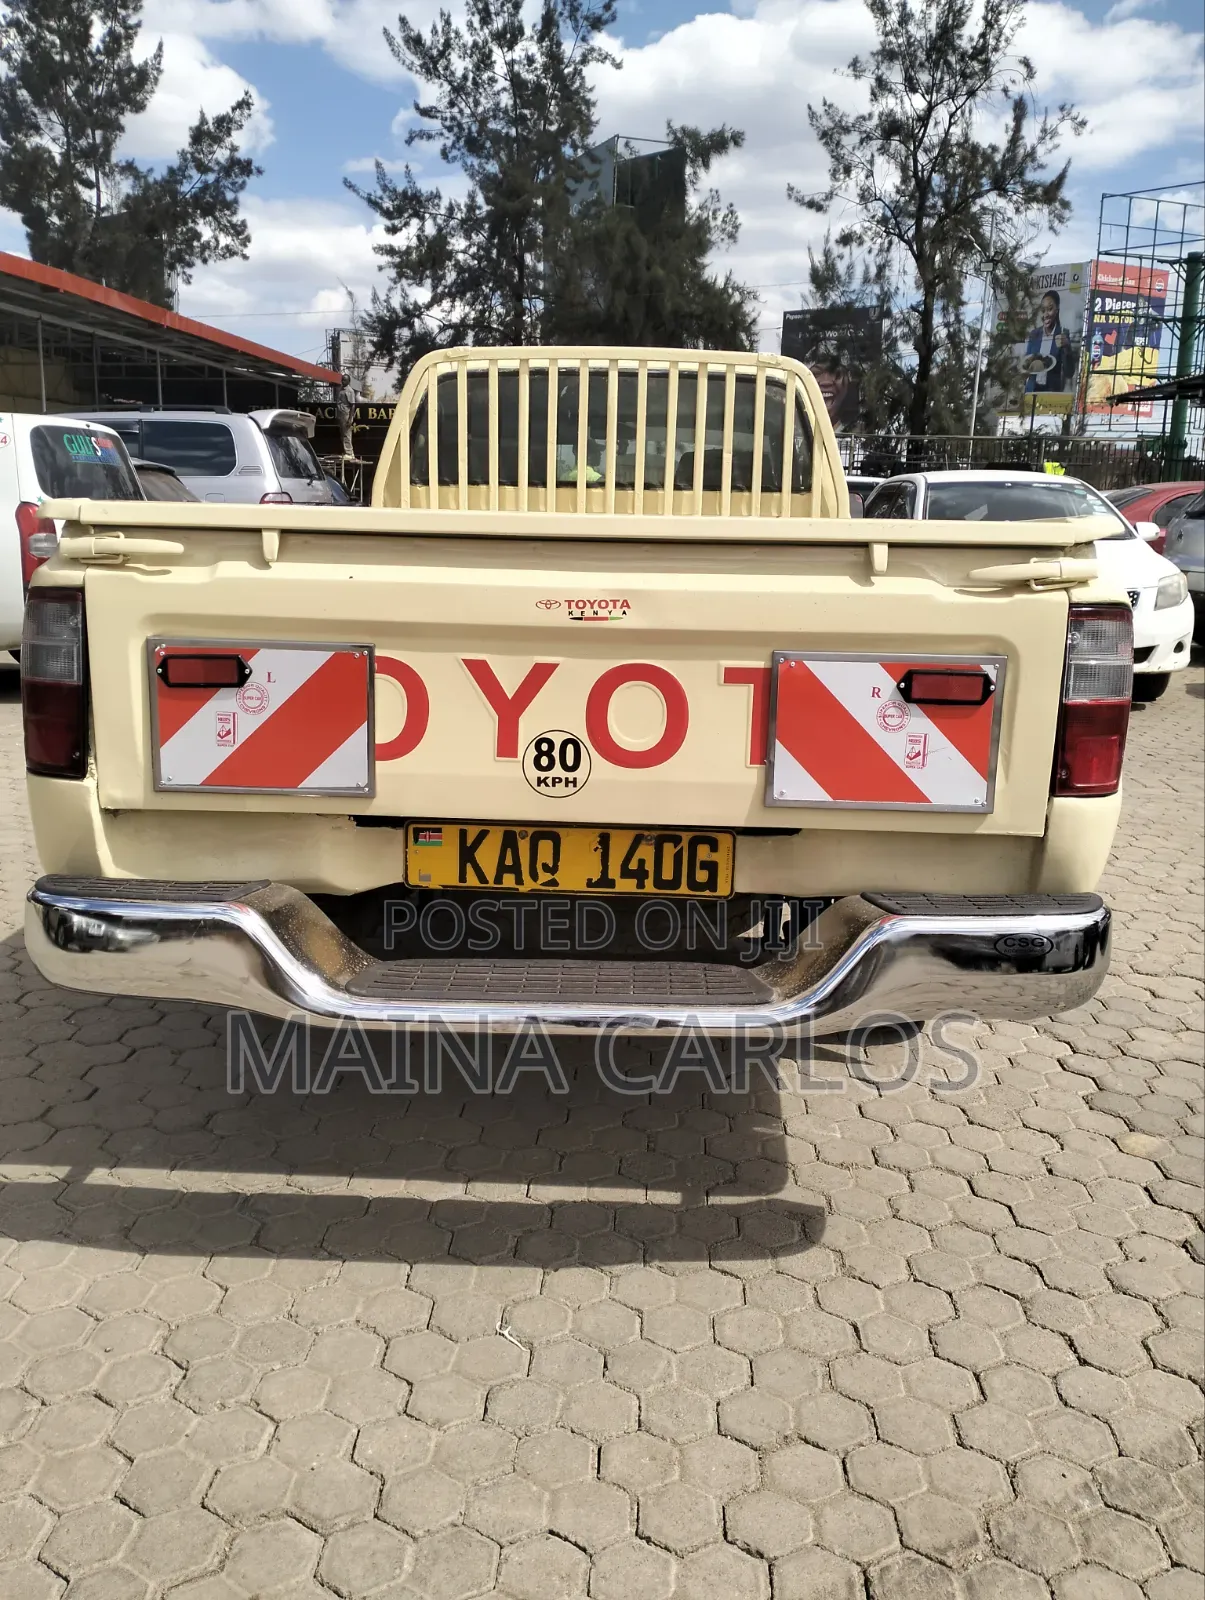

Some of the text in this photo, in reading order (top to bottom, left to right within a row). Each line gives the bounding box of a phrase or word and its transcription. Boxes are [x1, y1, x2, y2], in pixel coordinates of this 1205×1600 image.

[1094, 297, 1102, 312] 2
[564, 599, 631, 610] TOYOTA
[267, 671, 276, 683] L
[871, 686, 882, 699] R
[533, 736, 582, 773] 80
[536, 776, 578, 788] KPH
[458, 828, 562, 888] KAQ
[585, 832, 719, 893] 140G
[1003, 937, 1045, 947] CSG
